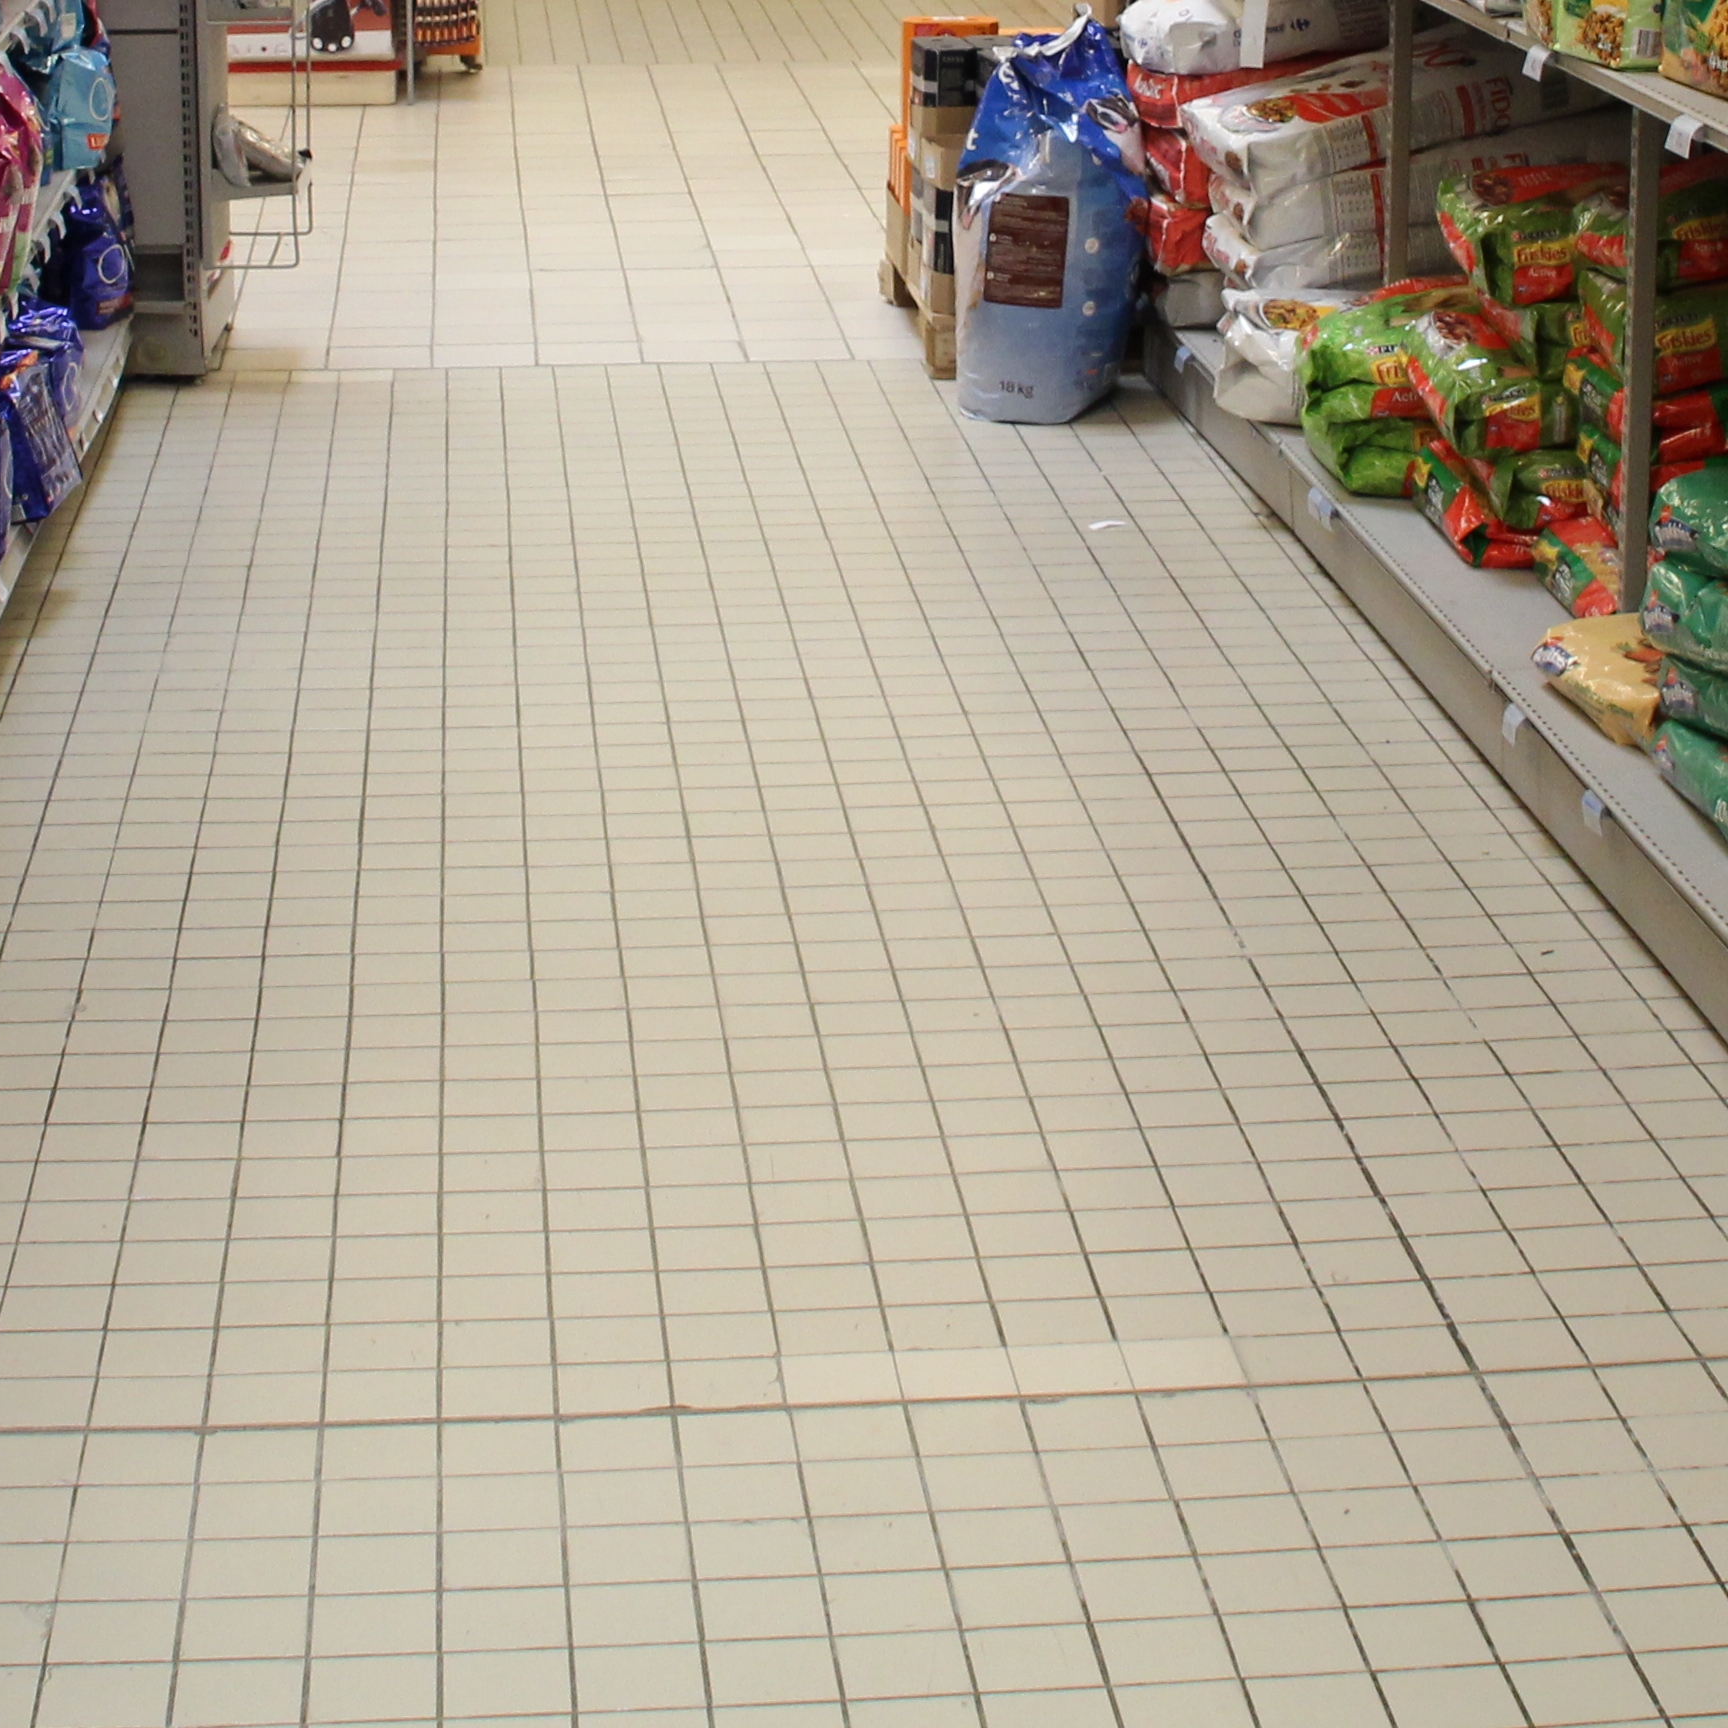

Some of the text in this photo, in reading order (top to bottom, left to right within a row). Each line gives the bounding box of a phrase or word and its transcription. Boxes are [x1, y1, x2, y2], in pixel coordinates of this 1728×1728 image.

[1514, 244, 1569, 265] Friskies
[1657, 328, 1718, 353] Friskies
[998, 380, 1034, 398] 18 kg
